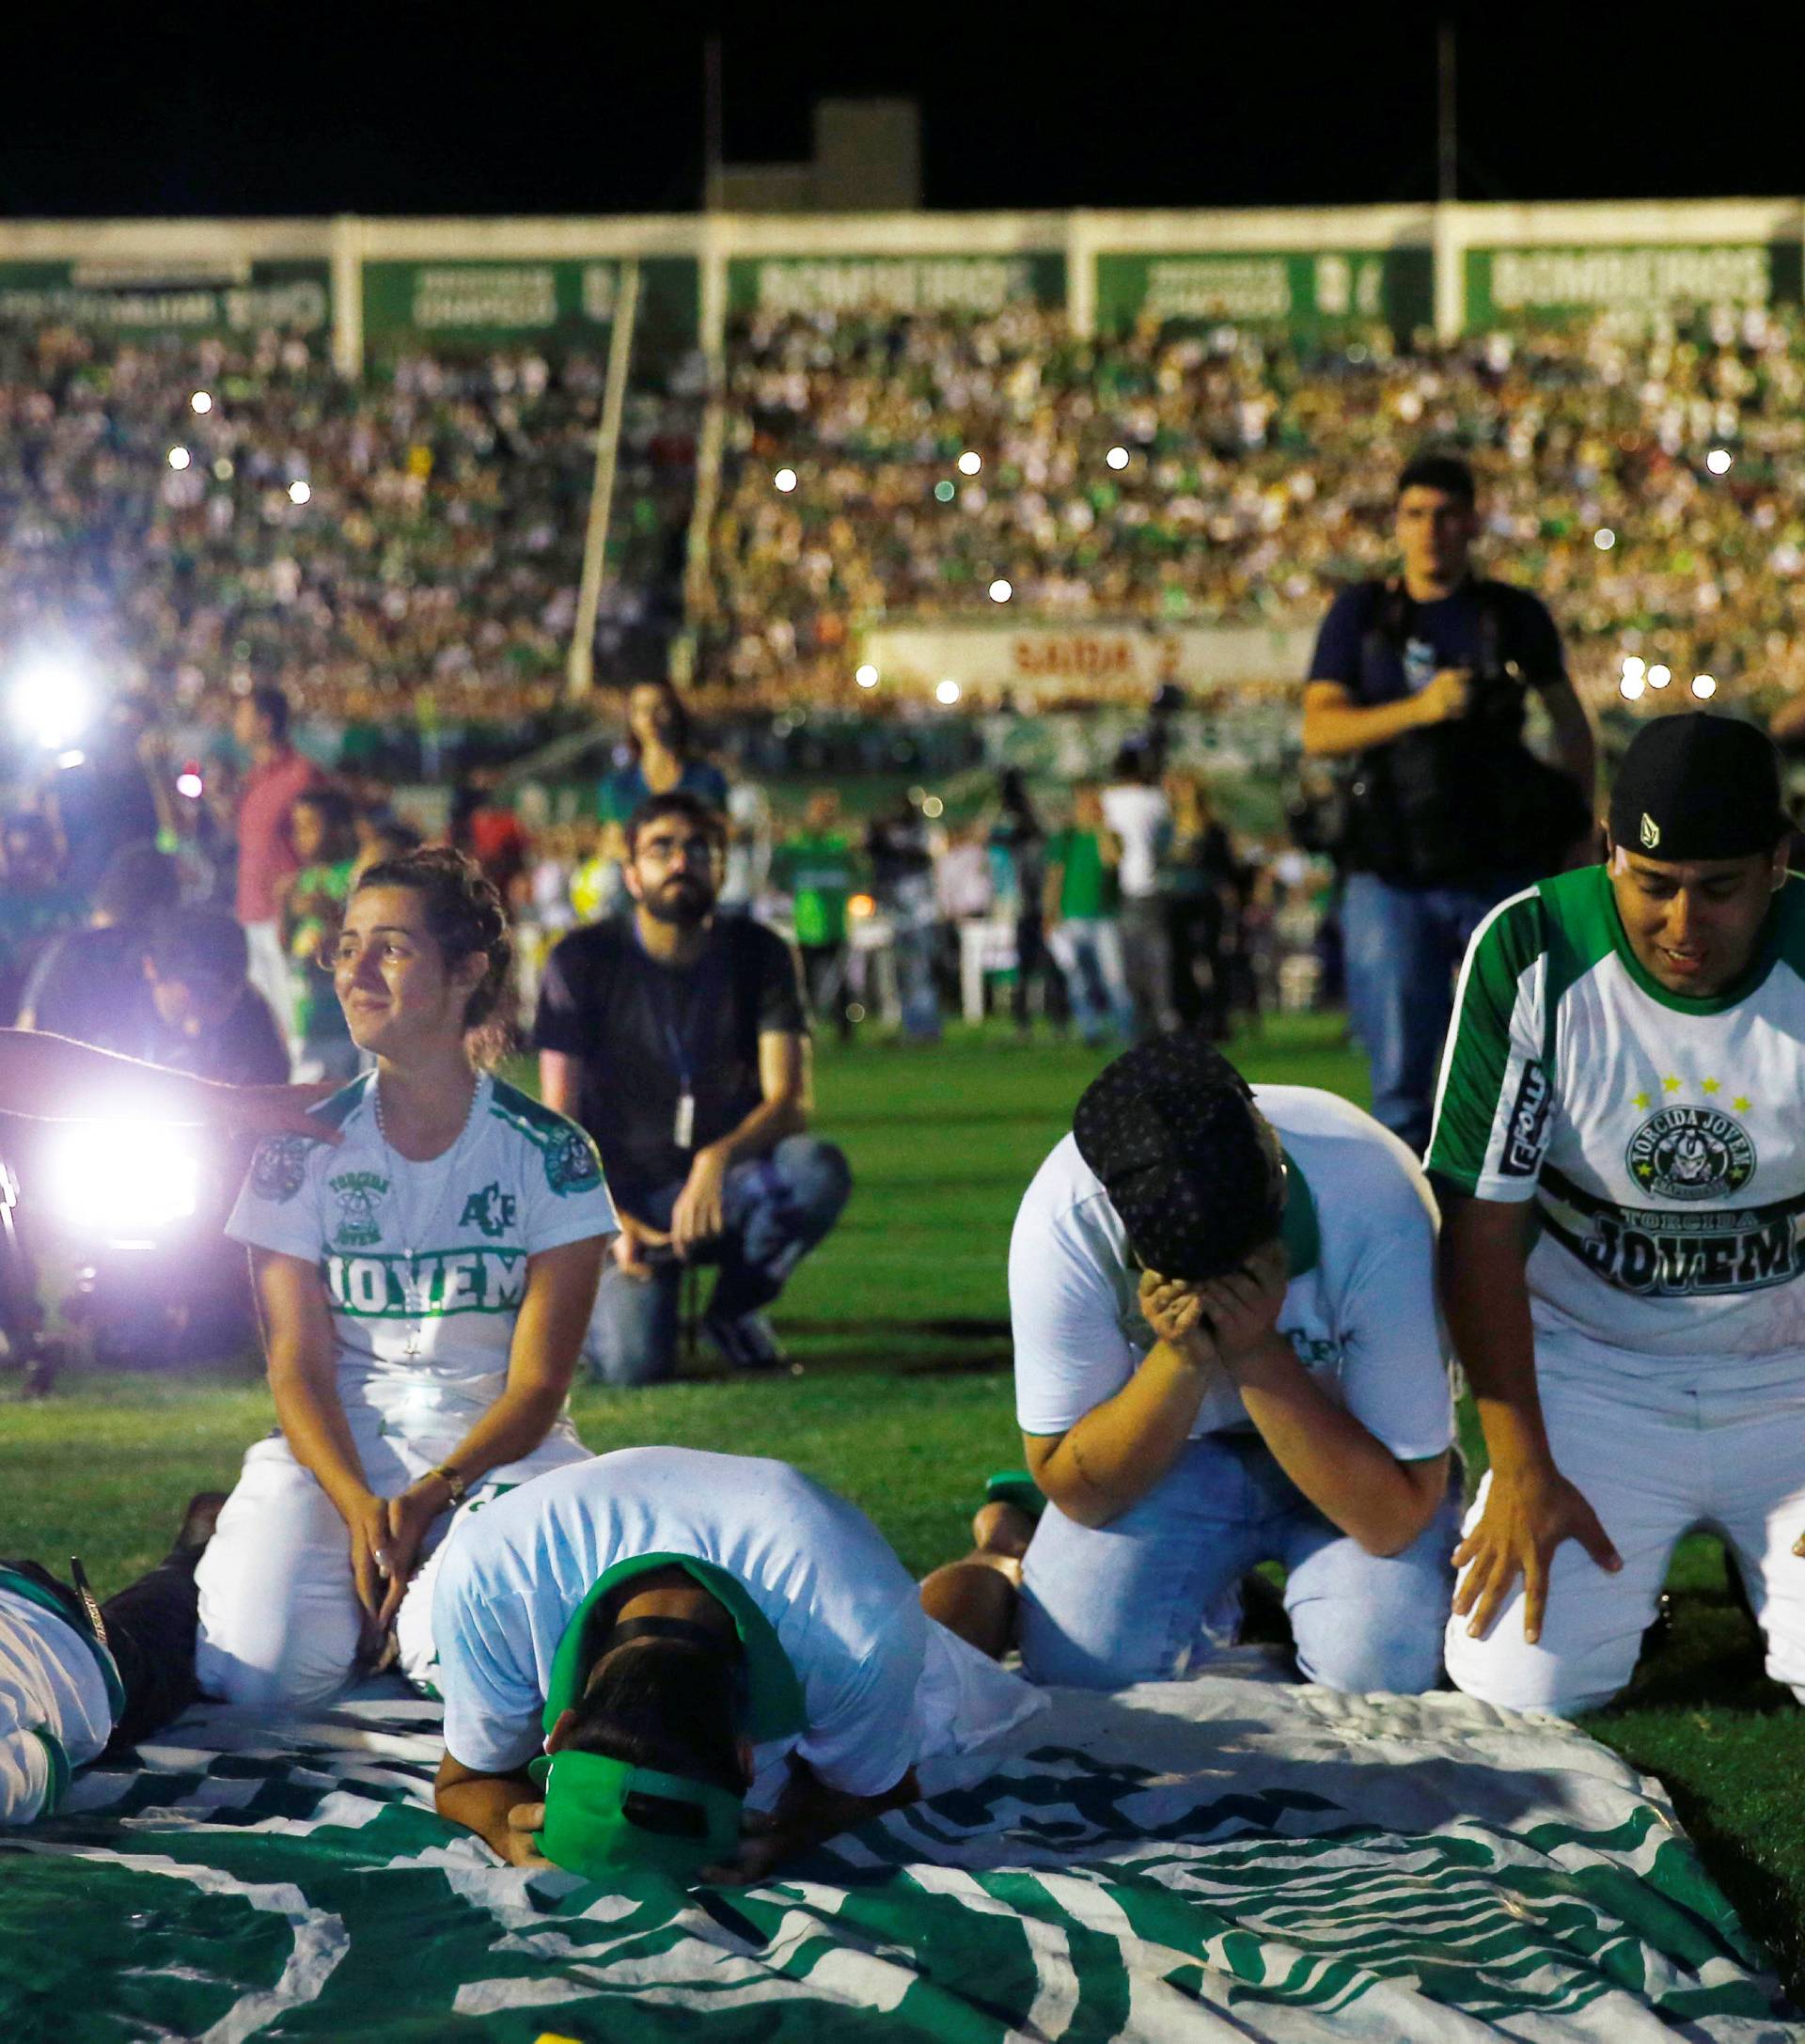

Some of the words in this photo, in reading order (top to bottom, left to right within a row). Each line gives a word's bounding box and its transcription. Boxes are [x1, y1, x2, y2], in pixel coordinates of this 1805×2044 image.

[1633, 1109, 1699, 1161] TORCIDA
[1702, 1113, 1751, 1165] JOVEM
[1620, 1208, 1760, 1231] TORCIDA
[1581, 1211, 1796, 1294] JOVEM
